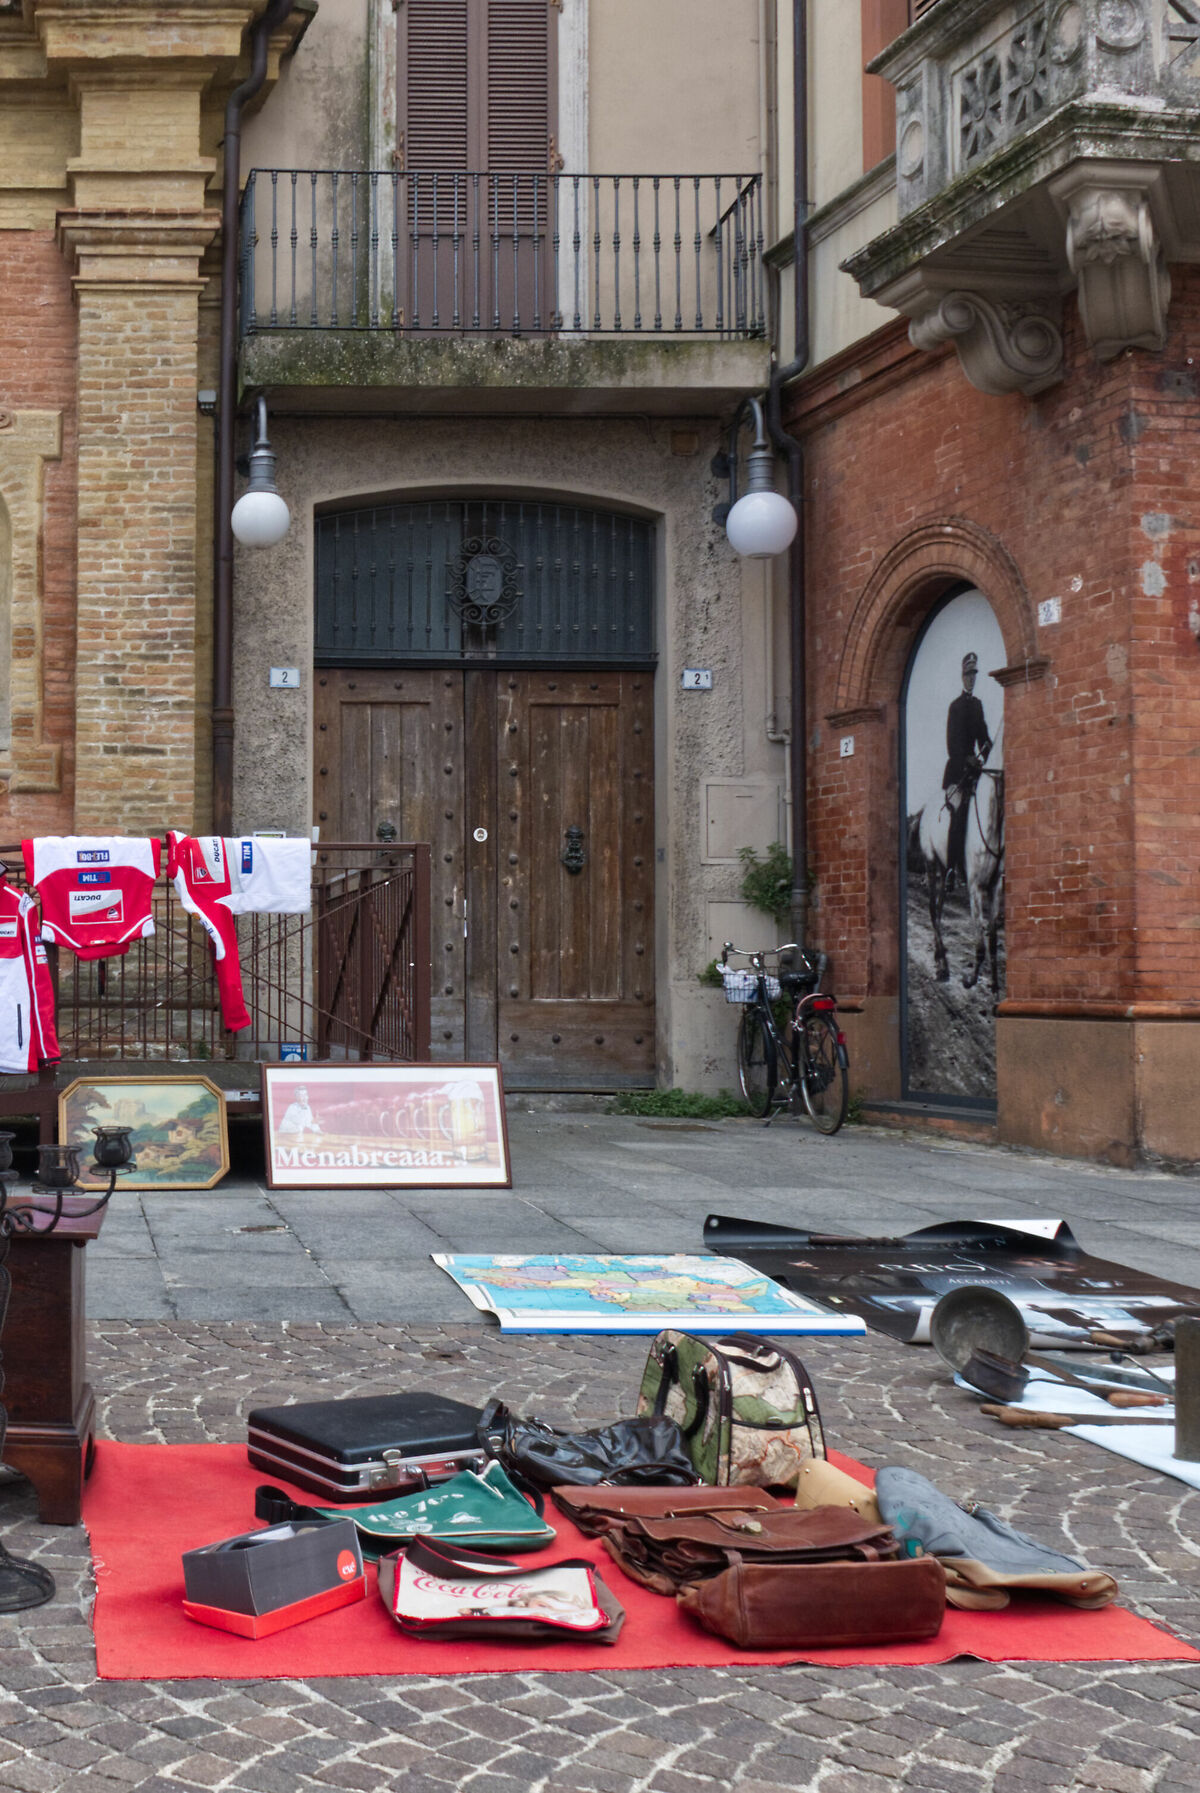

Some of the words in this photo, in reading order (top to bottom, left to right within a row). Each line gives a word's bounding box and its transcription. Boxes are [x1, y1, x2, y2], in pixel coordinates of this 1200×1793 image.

[282, 671, 288, 683] 2
[694, 672, 701, 685] 2
[243, 845, 251, 861] TIM
[82, 874, 98, 882] TIM
